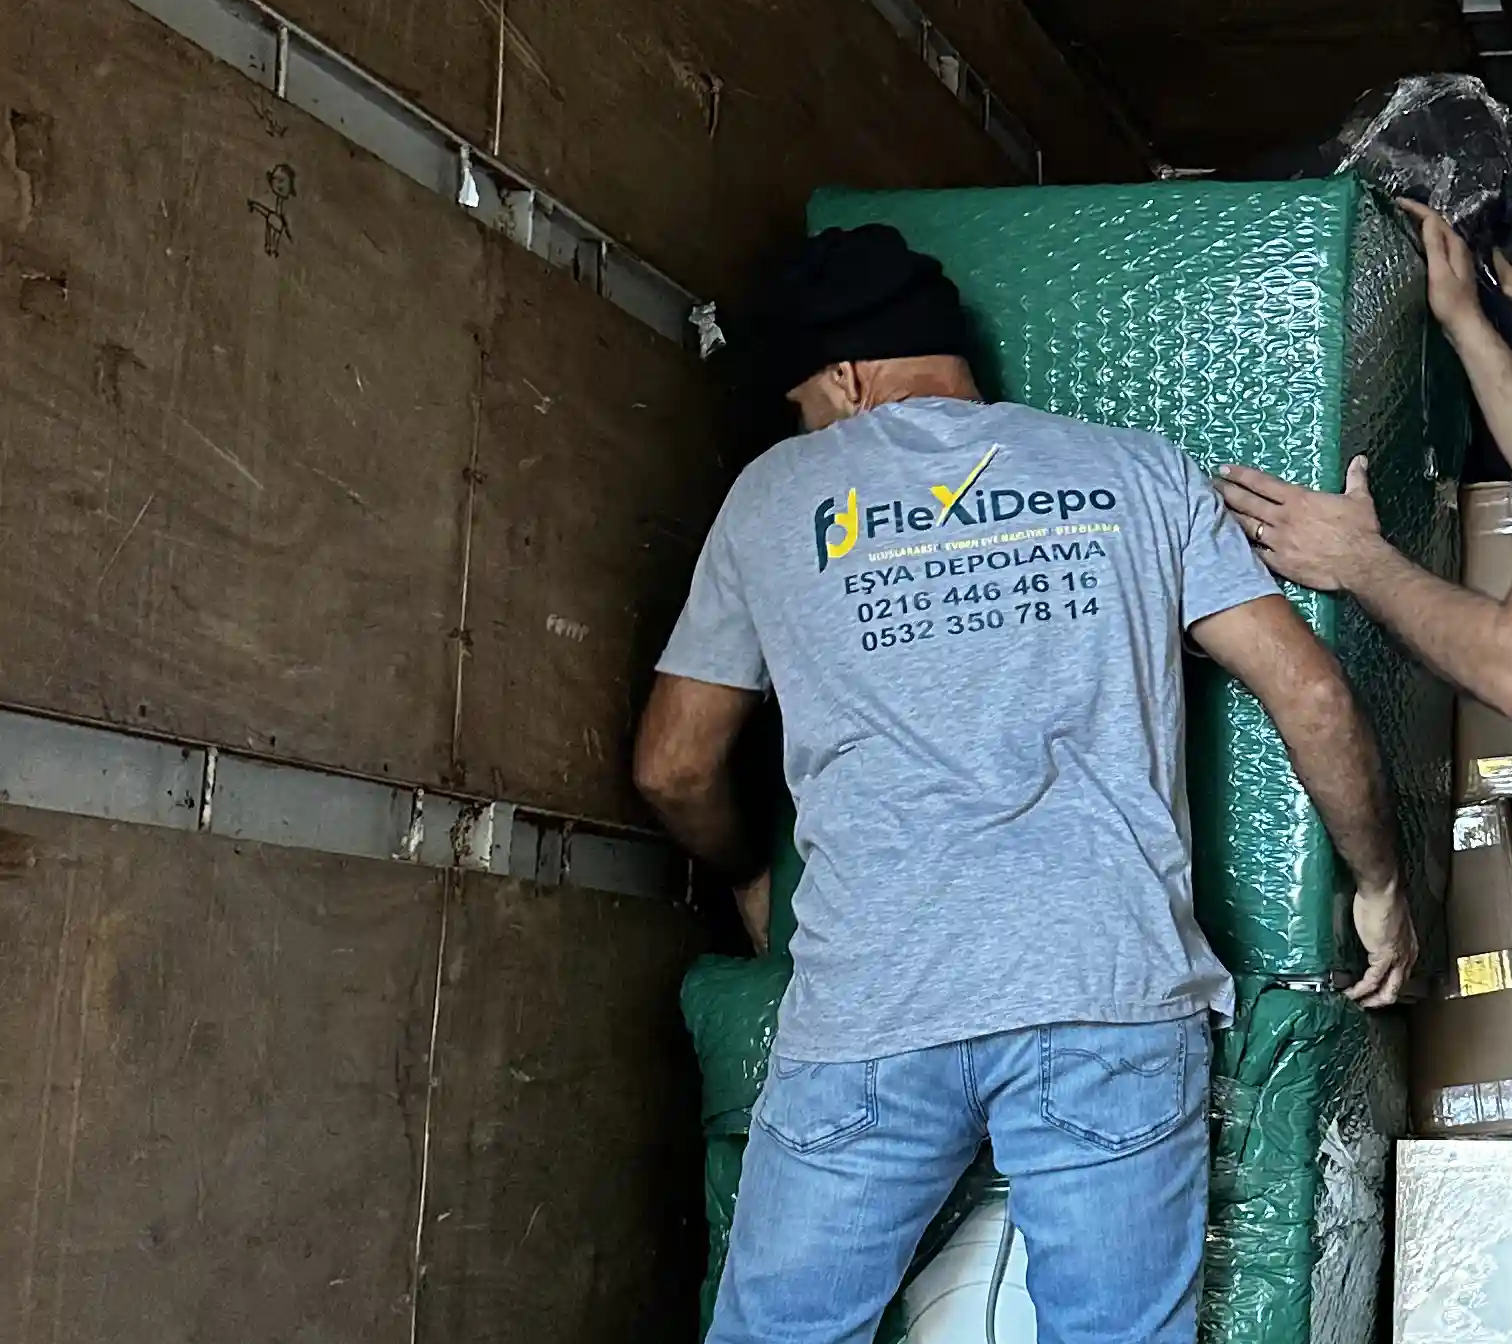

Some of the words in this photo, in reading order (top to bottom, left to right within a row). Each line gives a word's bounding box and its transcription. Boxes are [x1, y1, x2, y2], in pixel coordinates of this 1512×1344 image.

[844, 561, 915, 597] EŞYA
[924, 540, 1107, 580] DEPOLAMA
[856, 591, 932, 624] 0216
[942, 581, 1001, 607] 446
[1012, 572, 1050, 596] 46
[1061, 570, 1099, 592] 16
[861, 619, 935, 652] 0532
[946, 609, 1005, 636] 350
[1014, 601, 1052, 624] 78
[1064, 596, 1101, 619] 14
